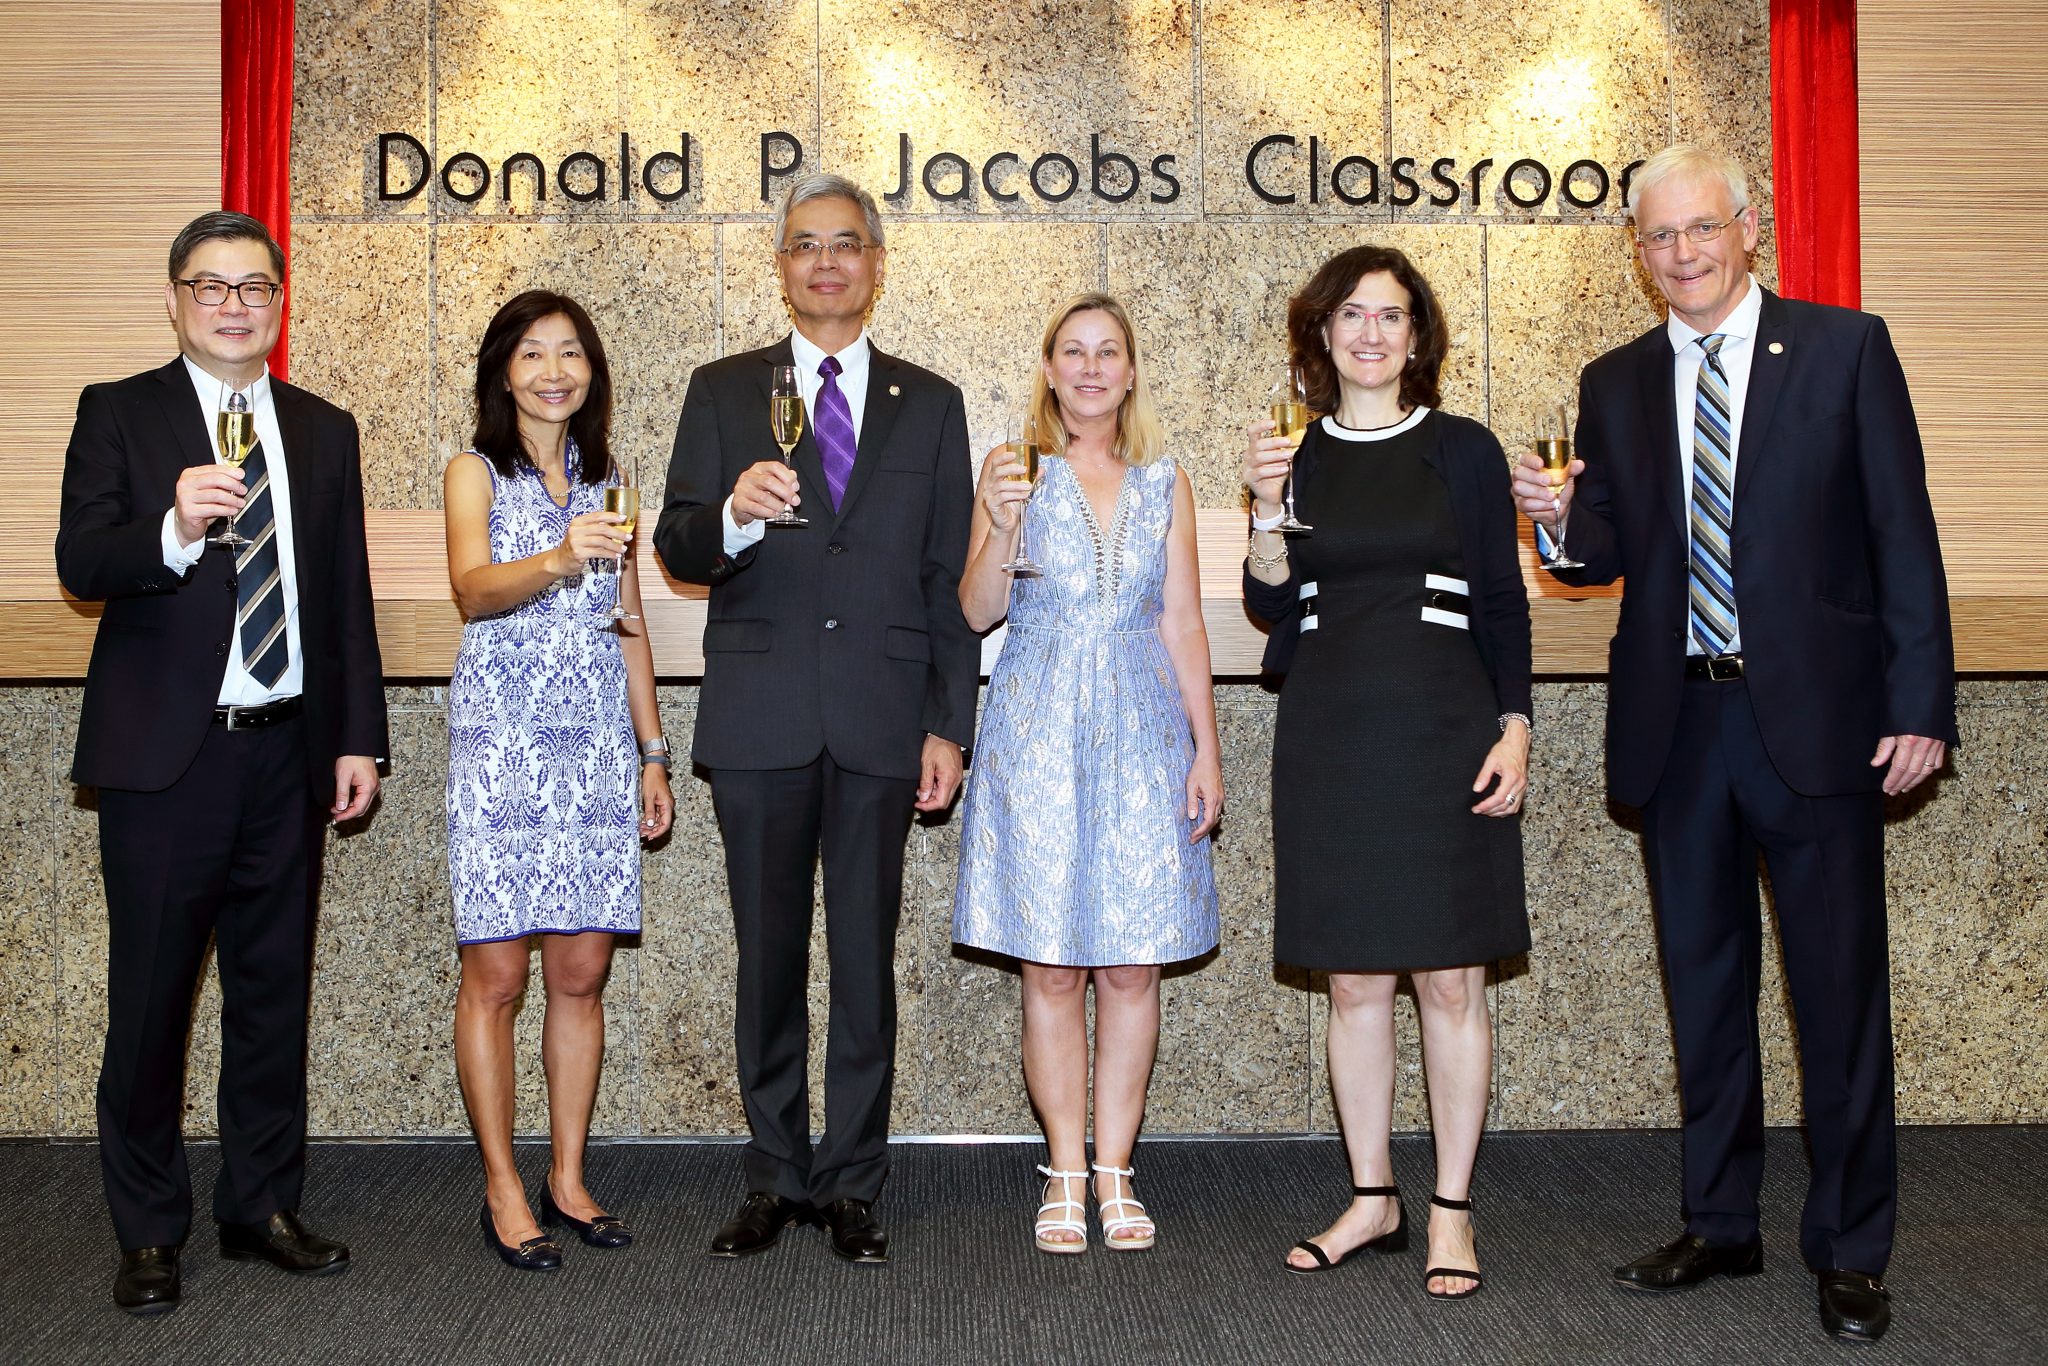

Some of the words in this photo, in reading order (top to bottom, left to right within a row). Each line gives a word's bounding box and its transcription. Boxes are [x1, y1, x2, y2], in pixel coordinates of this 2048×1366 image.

[378, 132, 691, 202] Donald
[761, 131, 803, 202] P
[883, 132, 1181, 202] Jacobs
